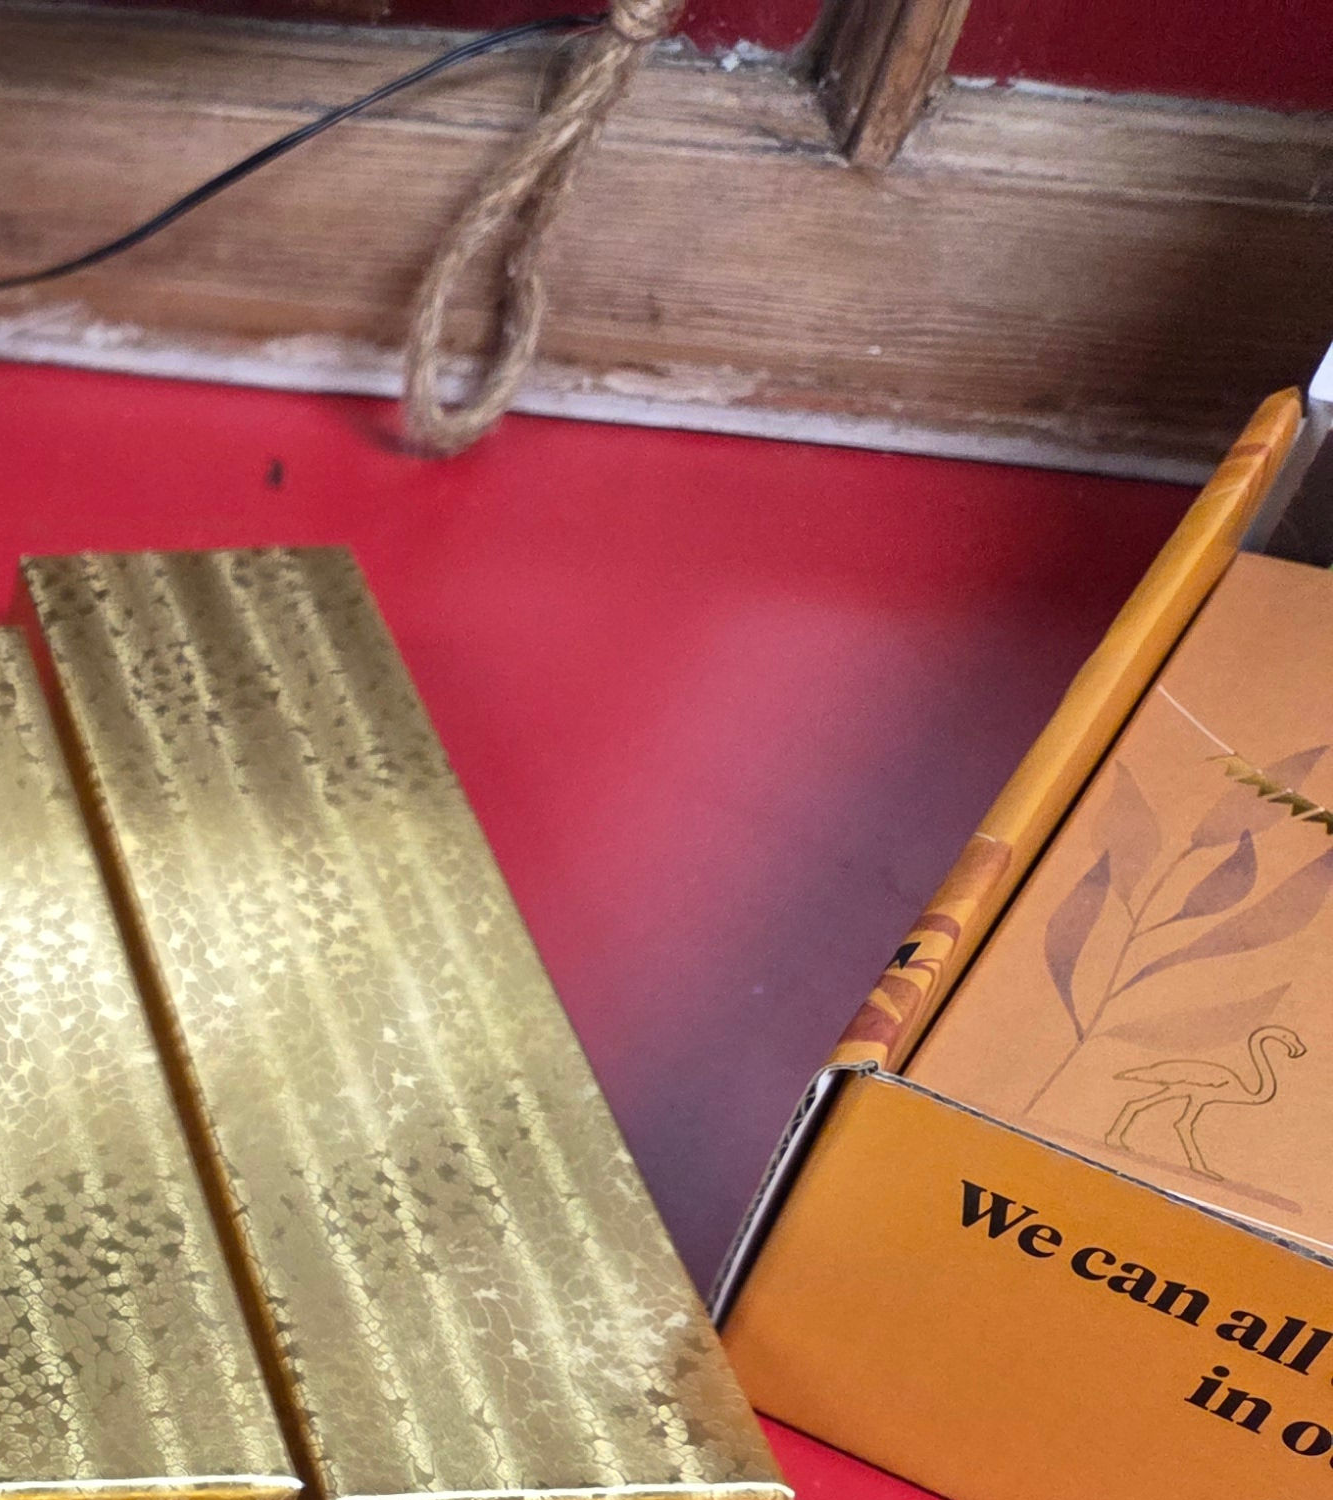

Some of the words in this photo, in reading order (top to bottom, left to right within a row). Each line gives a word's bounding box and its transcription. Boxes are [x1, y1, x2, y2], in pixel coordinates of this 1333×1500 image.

[960, 1179, 1063, 1259] We
[1070, 1246, 1211, 1327] can
[1215, 1310, 1333, 1376] all
[1184, 1365, 1273, 1434] in
[1281, 1421, 1333, 1468] o
